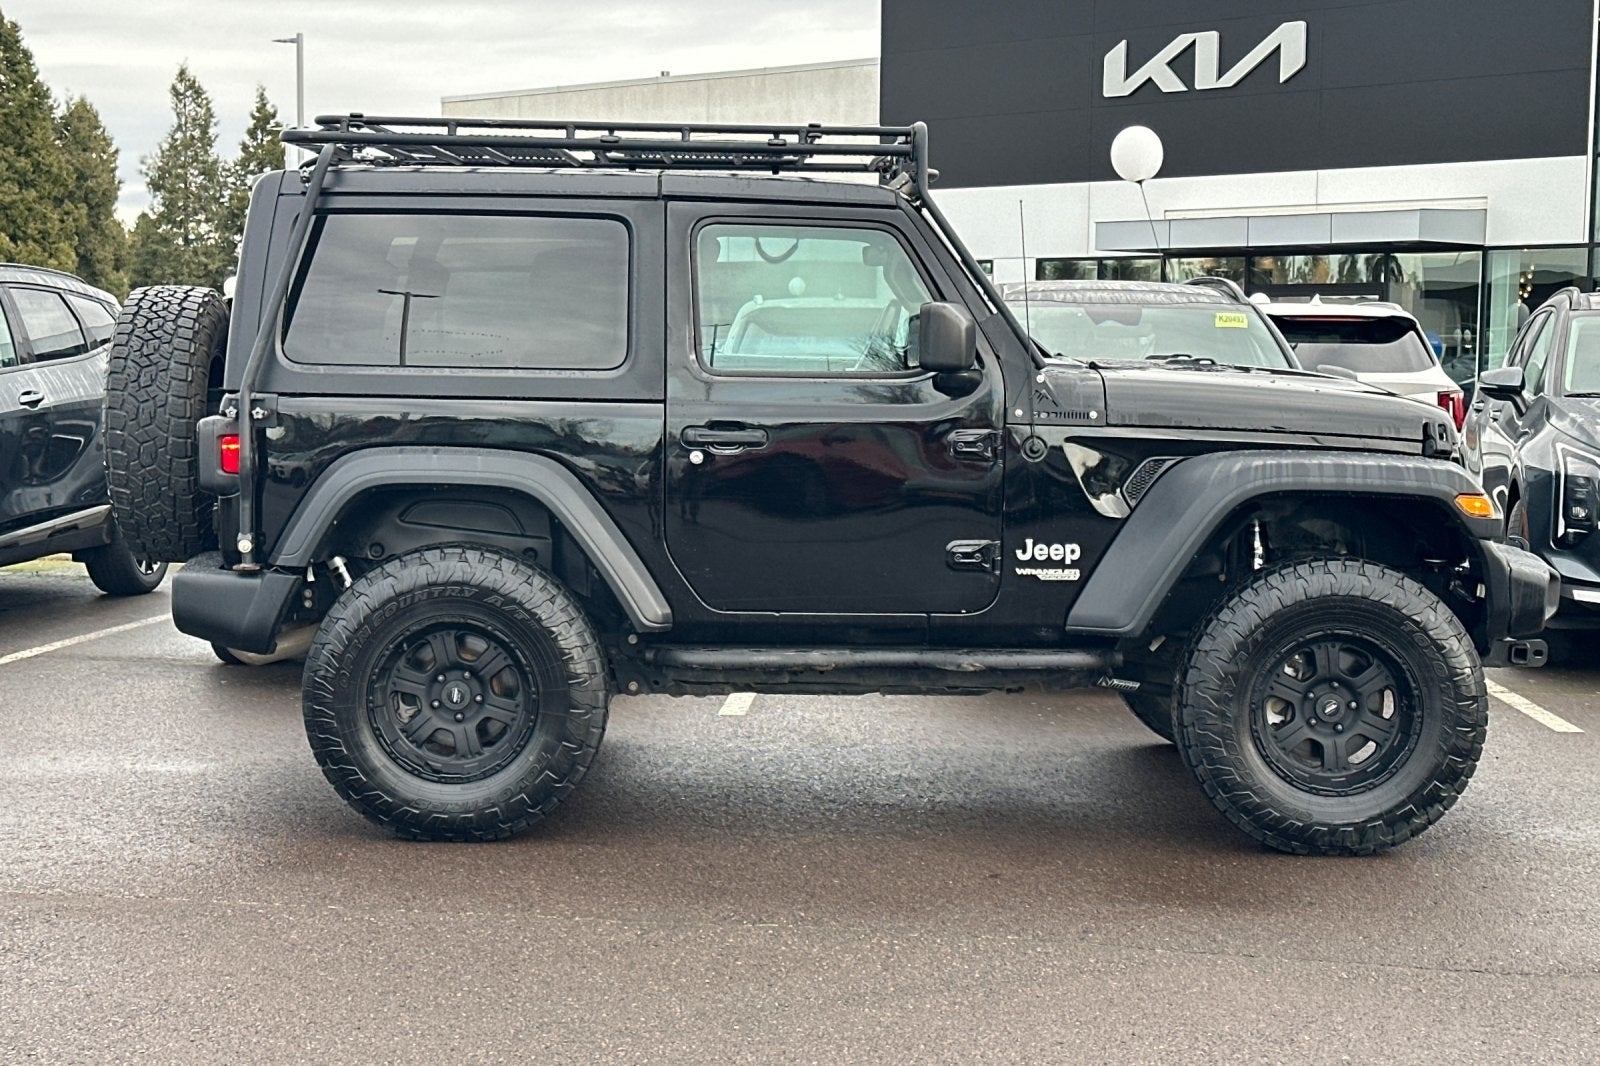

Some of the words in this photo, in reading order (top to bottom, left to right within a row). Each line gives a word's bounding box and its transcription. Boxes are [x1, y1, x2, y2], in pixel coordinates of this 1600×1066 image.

[1103, 20, 1307, 98] KIA
[1015, 538, 1081, 565] Jeep
[1015, 567, 1081, 576] WRANGLER
[338, 624, 372, 688] OPEN
[372, 586, 479, 627] COUNTRY
[1400, 620, 1449, 678] TOYO
[499, 751, 551, 802] TOYO
[409, 797, 494, 813] TIRES
